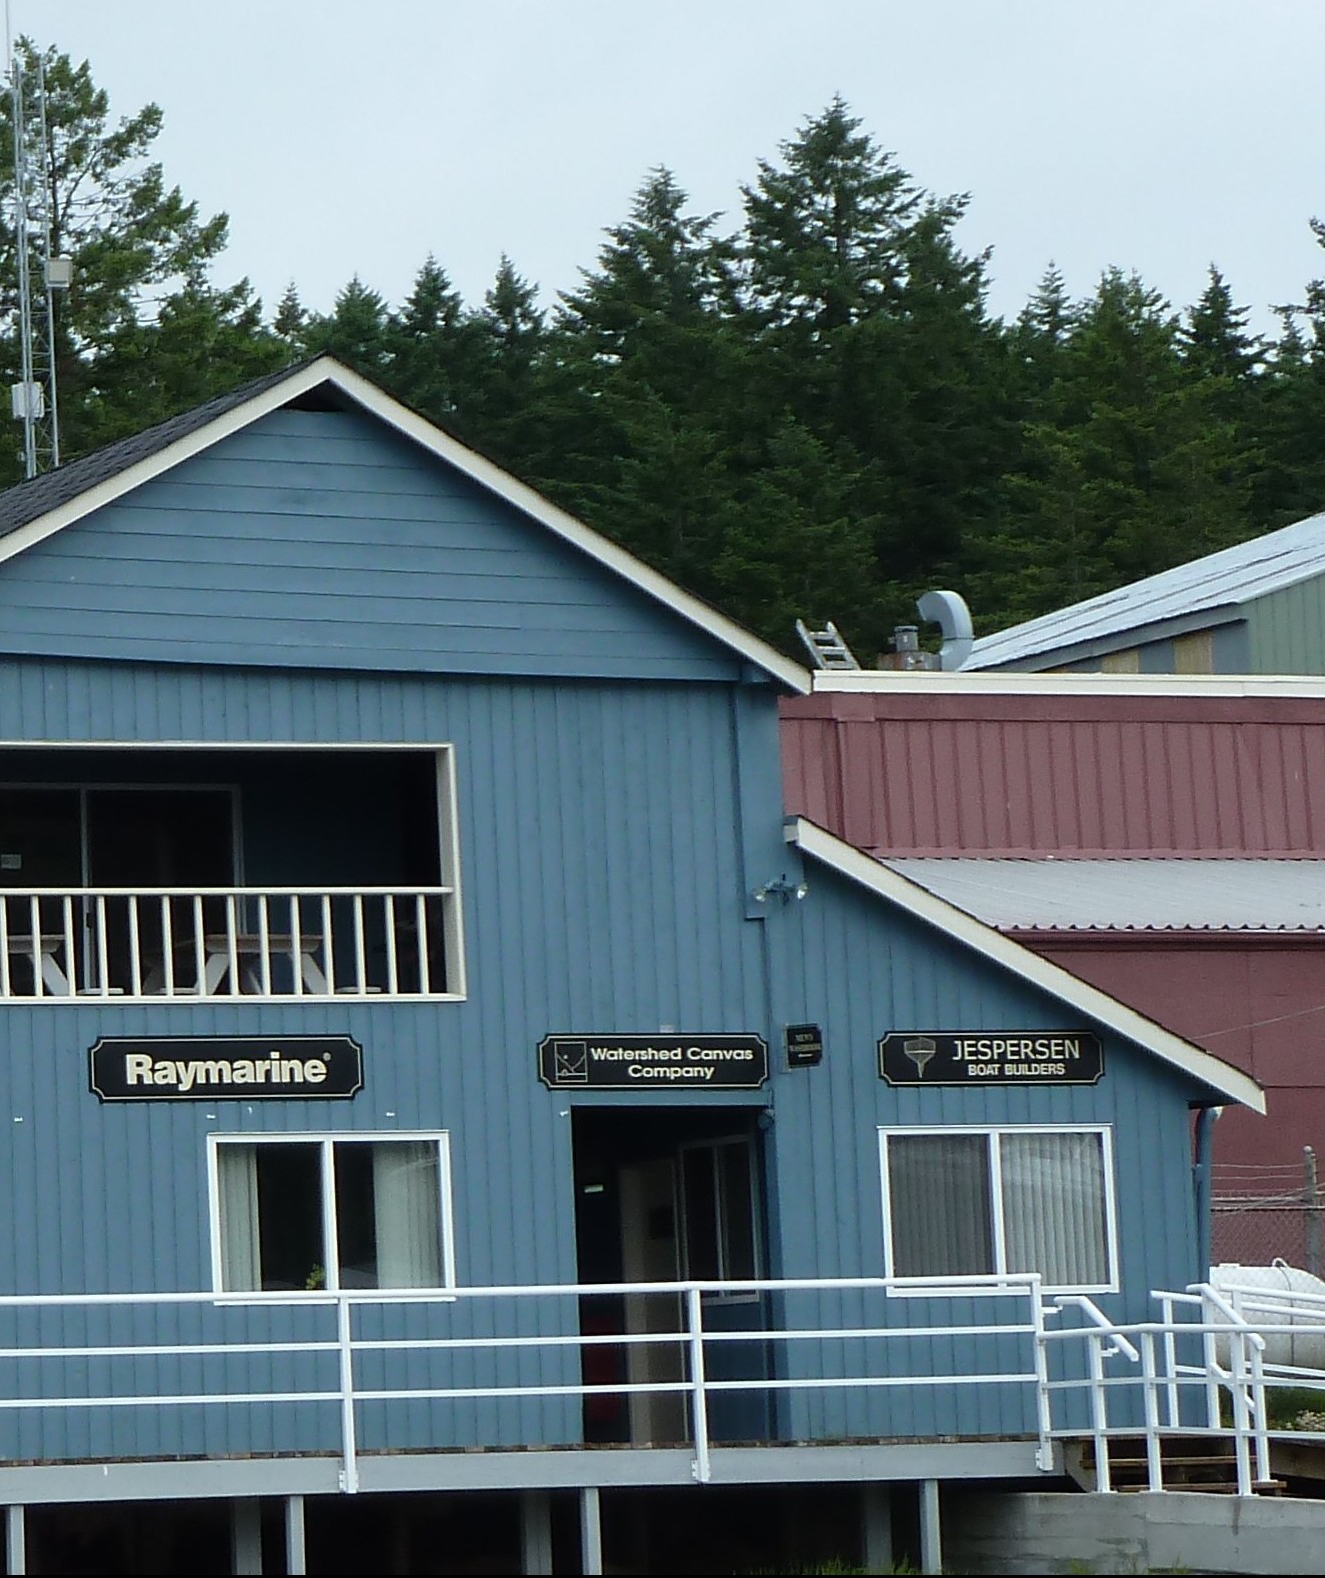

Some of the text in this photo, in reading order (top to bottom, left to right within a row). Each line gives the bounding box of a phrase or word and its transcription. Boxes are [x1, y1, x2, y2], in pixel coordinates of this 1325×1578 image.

[590, 1047, 754, 1060] Watershed Canvas
[952, 1039, 1080, 1060] JESPERSEN
[628, 1064, 715, 1080] Company
[968, 1063, 1066, 1076] BOAT BUILDERS
